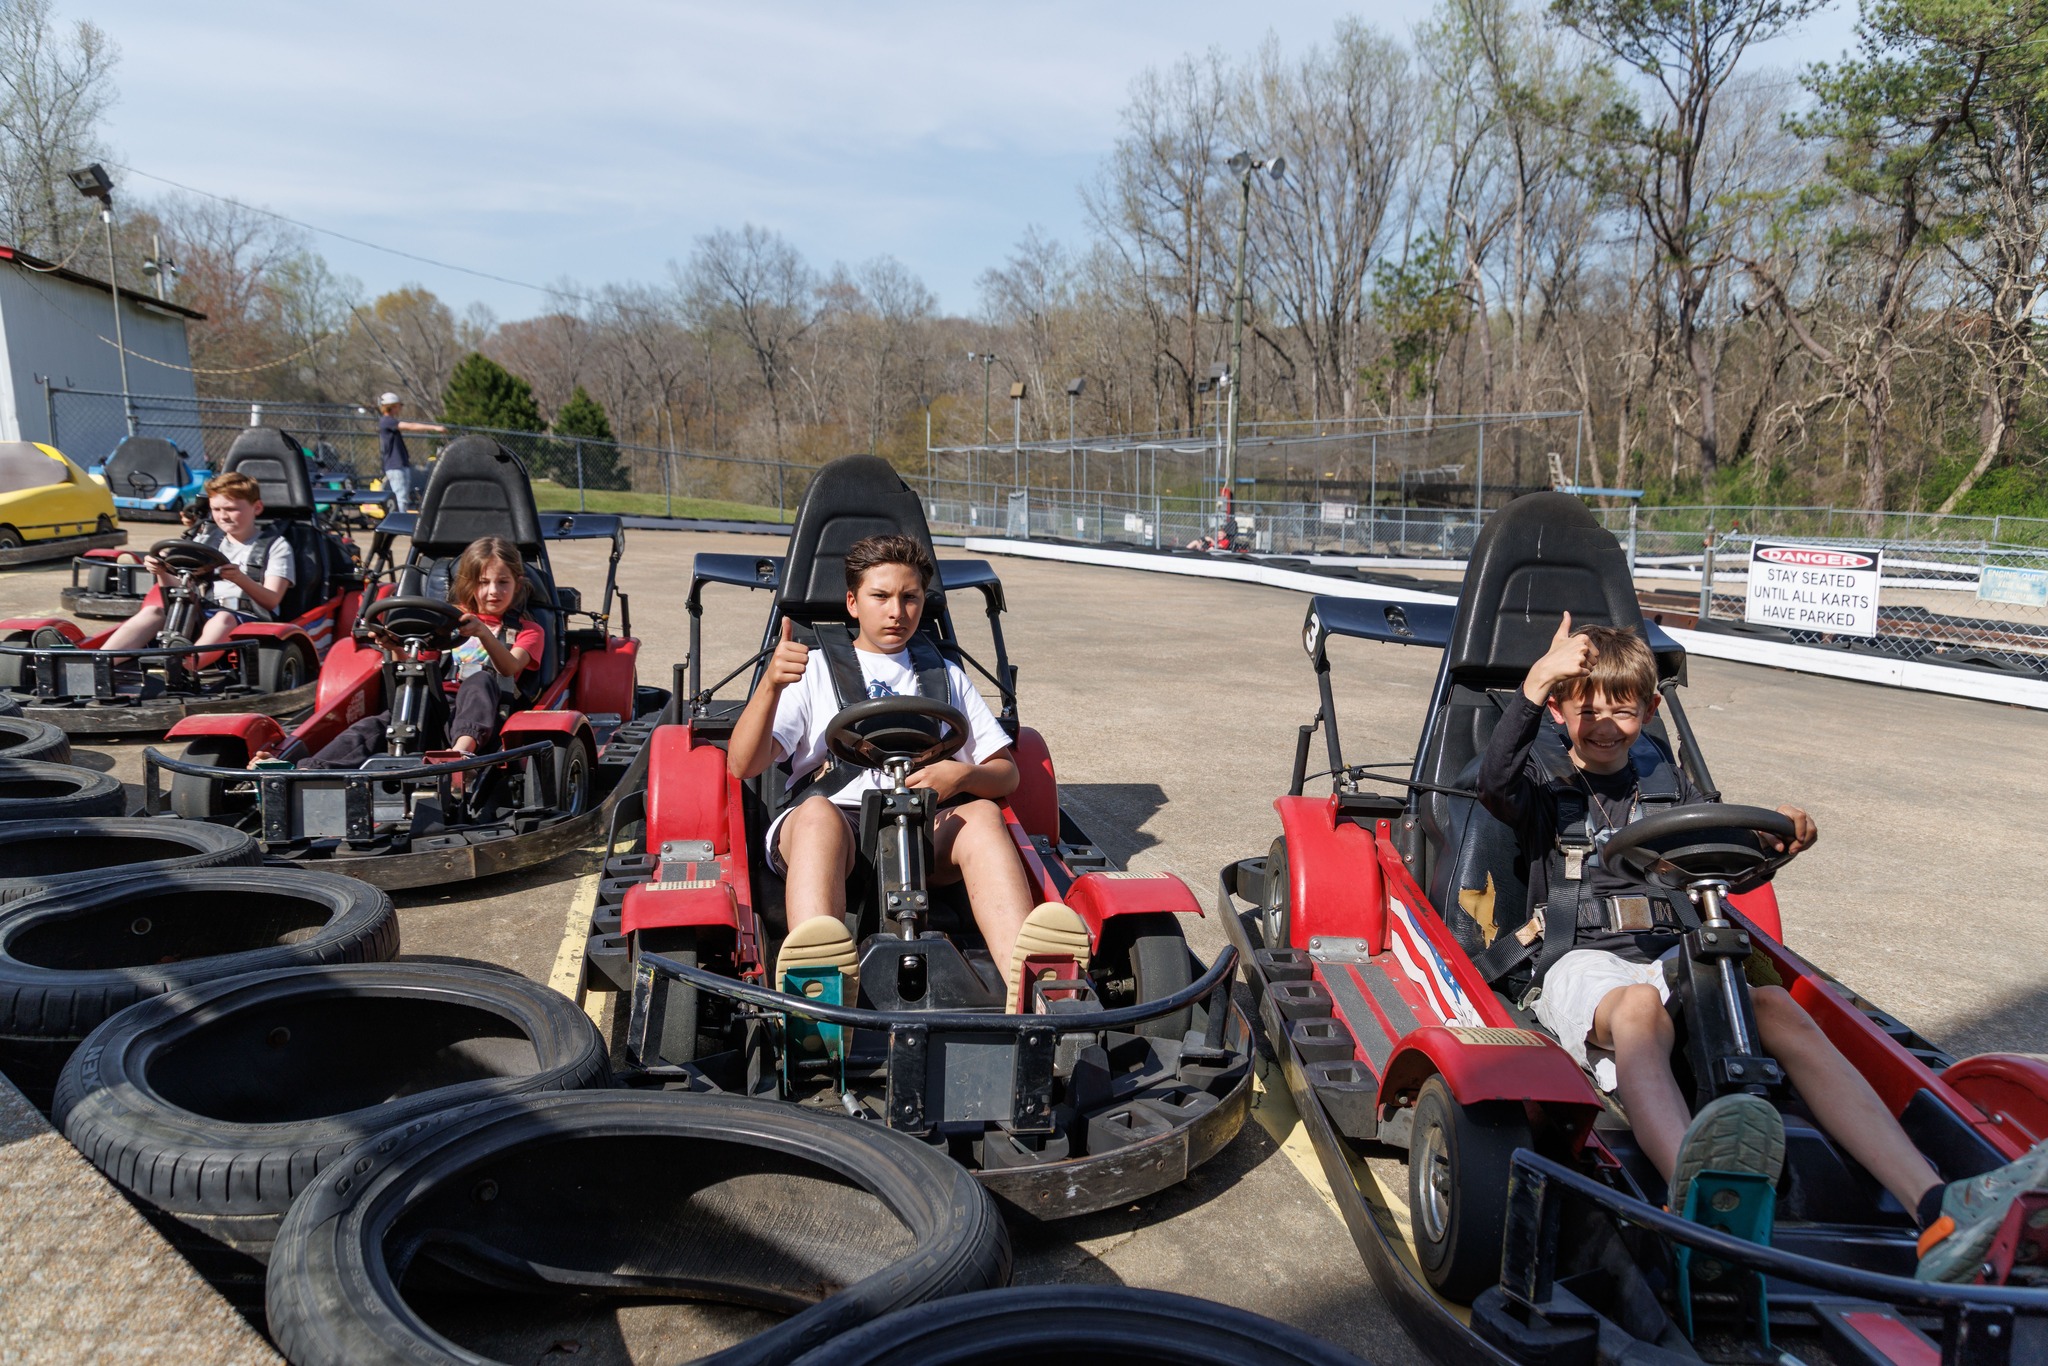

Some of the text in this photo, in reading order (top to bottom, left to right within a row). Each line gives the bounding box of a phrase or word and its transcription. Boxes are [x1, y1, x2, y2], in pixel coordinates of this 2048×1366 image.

[1768, 550, 1858, 566] DANGER
[1768, 568, 1856, 588] STAY SEATED
[1754, 585, 1869, 609] UNTIL ALL KARTS
[1763, 604, 1855, 627] HAVE PARKED
[1306, 612, 1320, 653] 3
